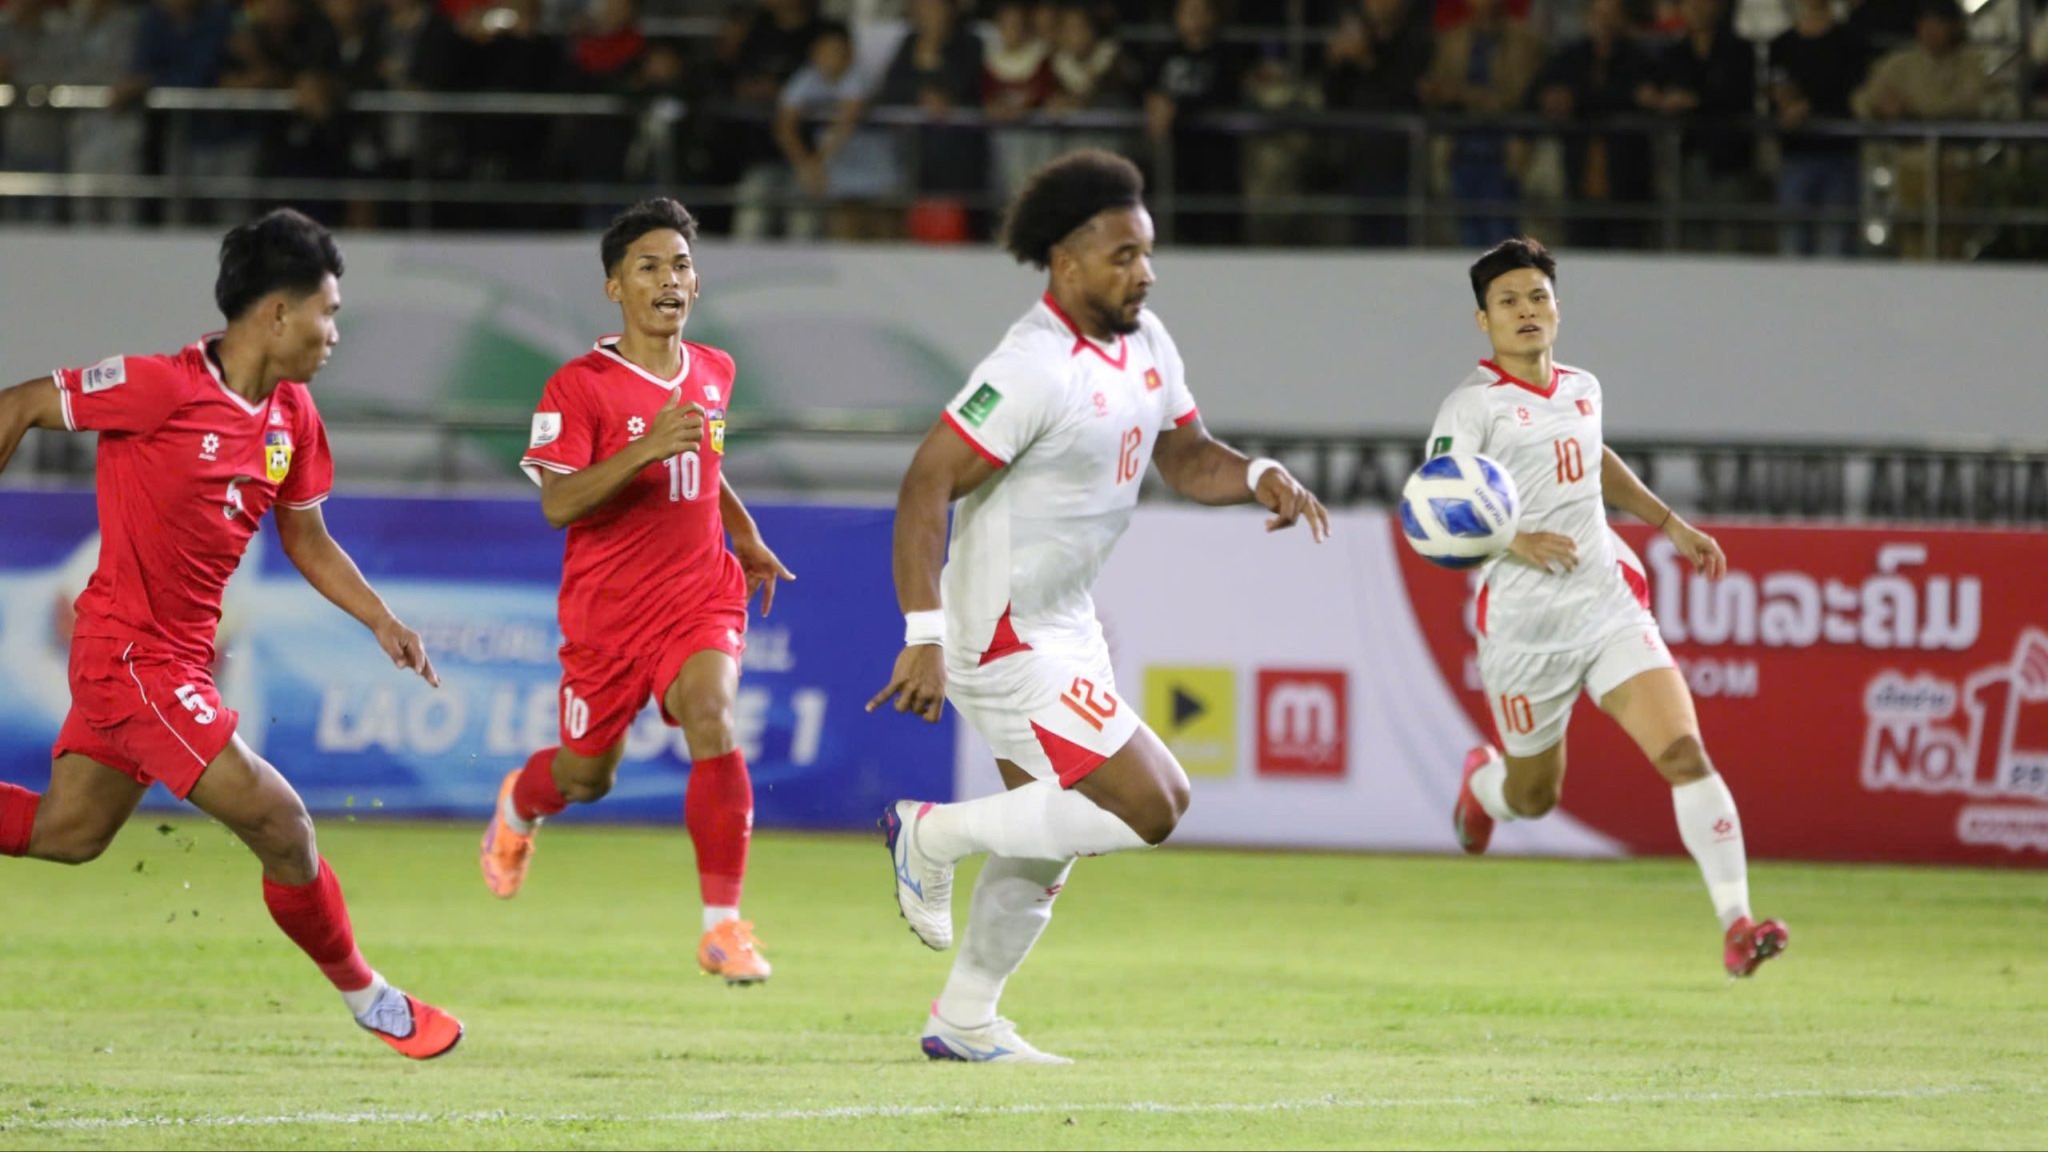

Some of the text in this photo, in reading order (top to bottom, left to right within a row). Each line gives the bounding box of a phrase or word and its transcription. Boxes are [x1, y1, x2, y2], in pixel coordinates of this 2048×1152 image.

[663, 450, 700, 502] 10
[1116, 426, 1142, 485] 12
[1554, 437, 1584, 484] 10
[222, 474, 253, 521] 5
[174, 683, 217, 725] 5
[316, 686, 468, 758] LAO
[790, 688, 829, 768] 1
[563, 686, 589, 740] 10
[1060, 676, 1118, 733] 12
[1501, 692, 1534, 736] 10
